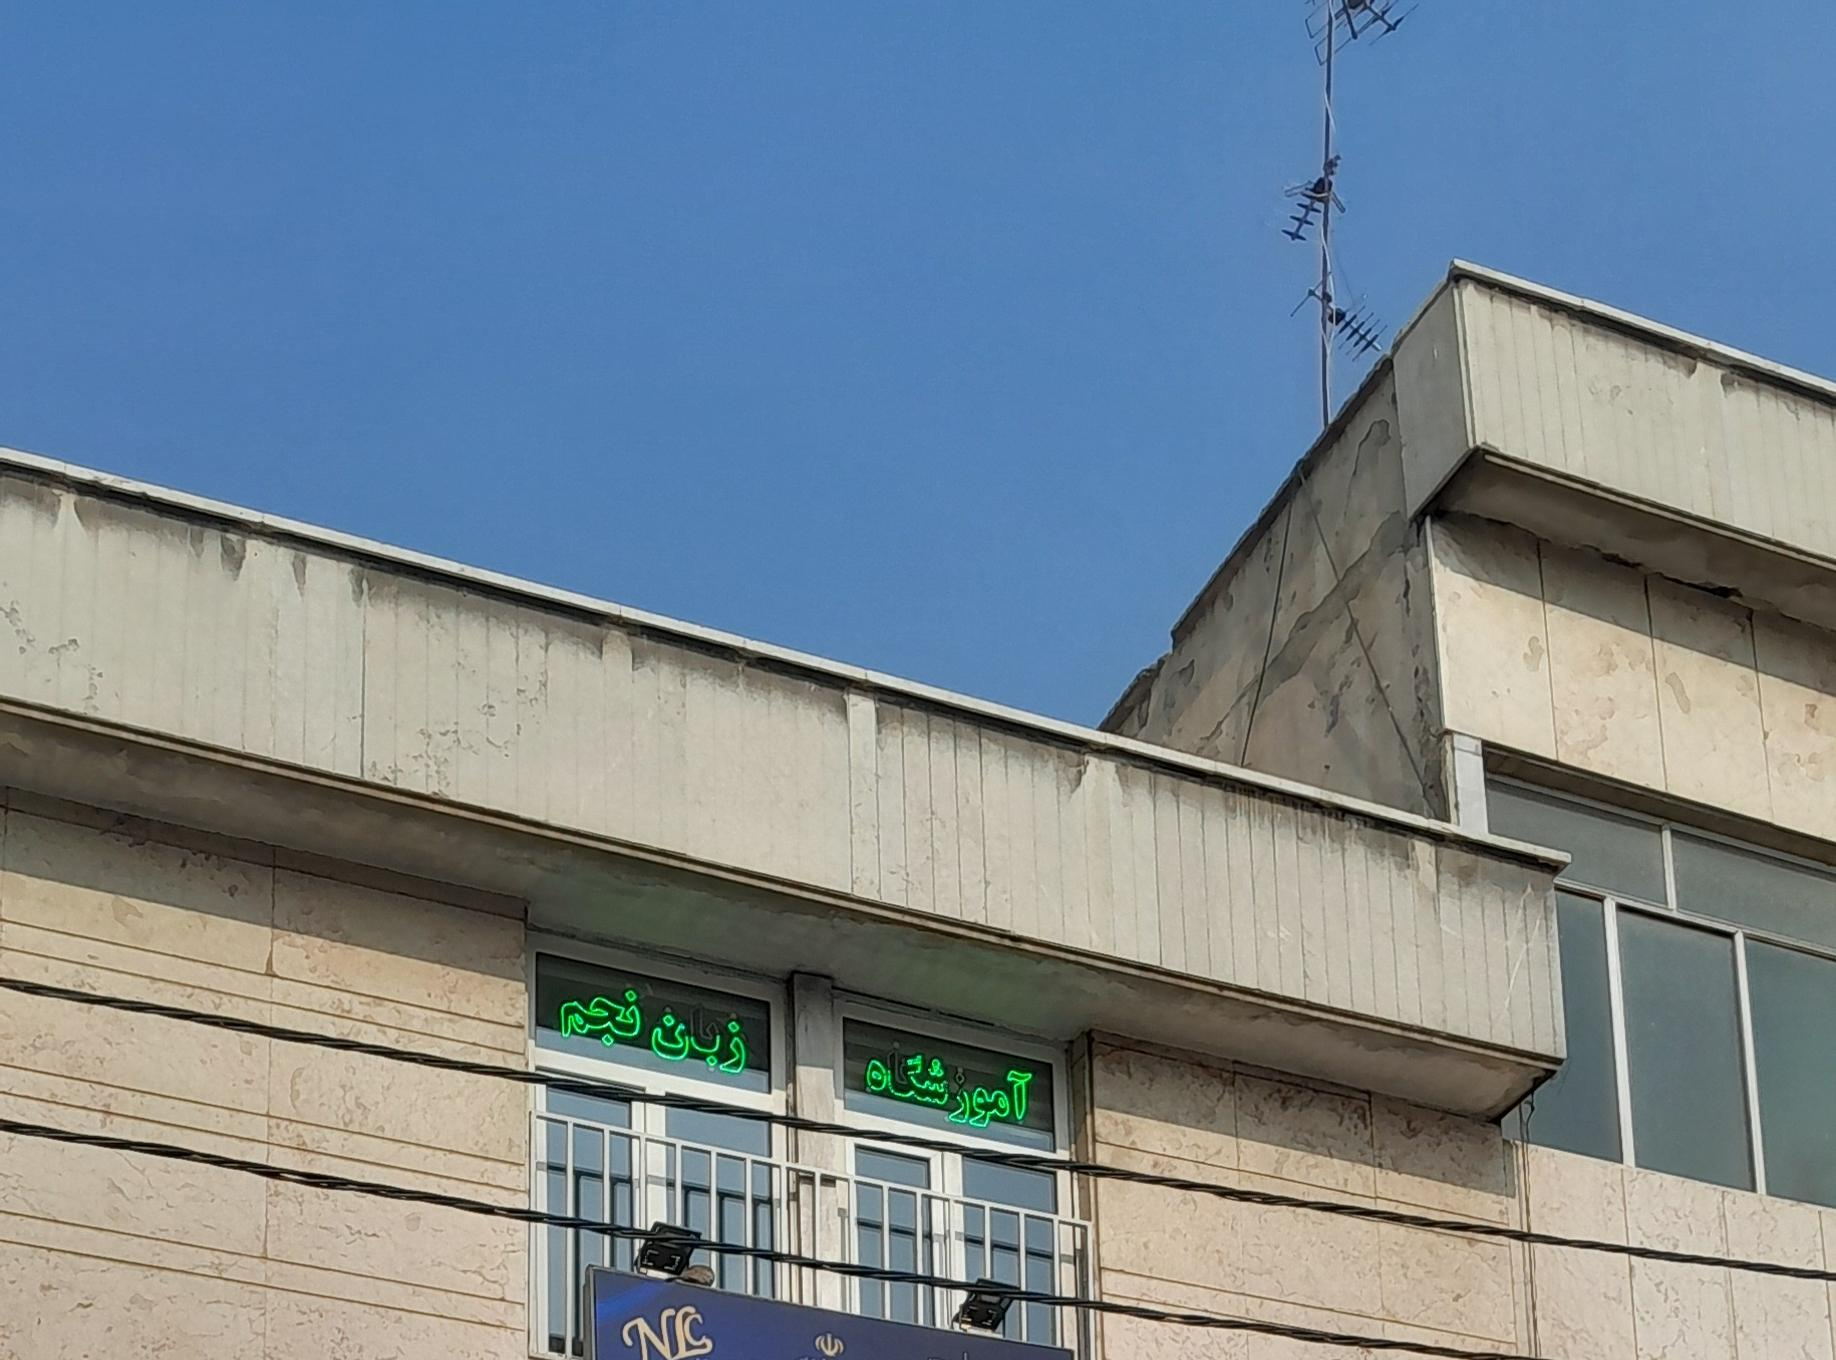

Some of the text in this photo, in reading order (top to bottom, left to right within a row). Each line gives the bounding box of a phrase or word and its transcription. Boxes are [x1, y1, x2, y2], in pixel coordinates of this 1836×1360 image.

[558, 988, 1034, 1128] آموزشگاه زبان نجم
